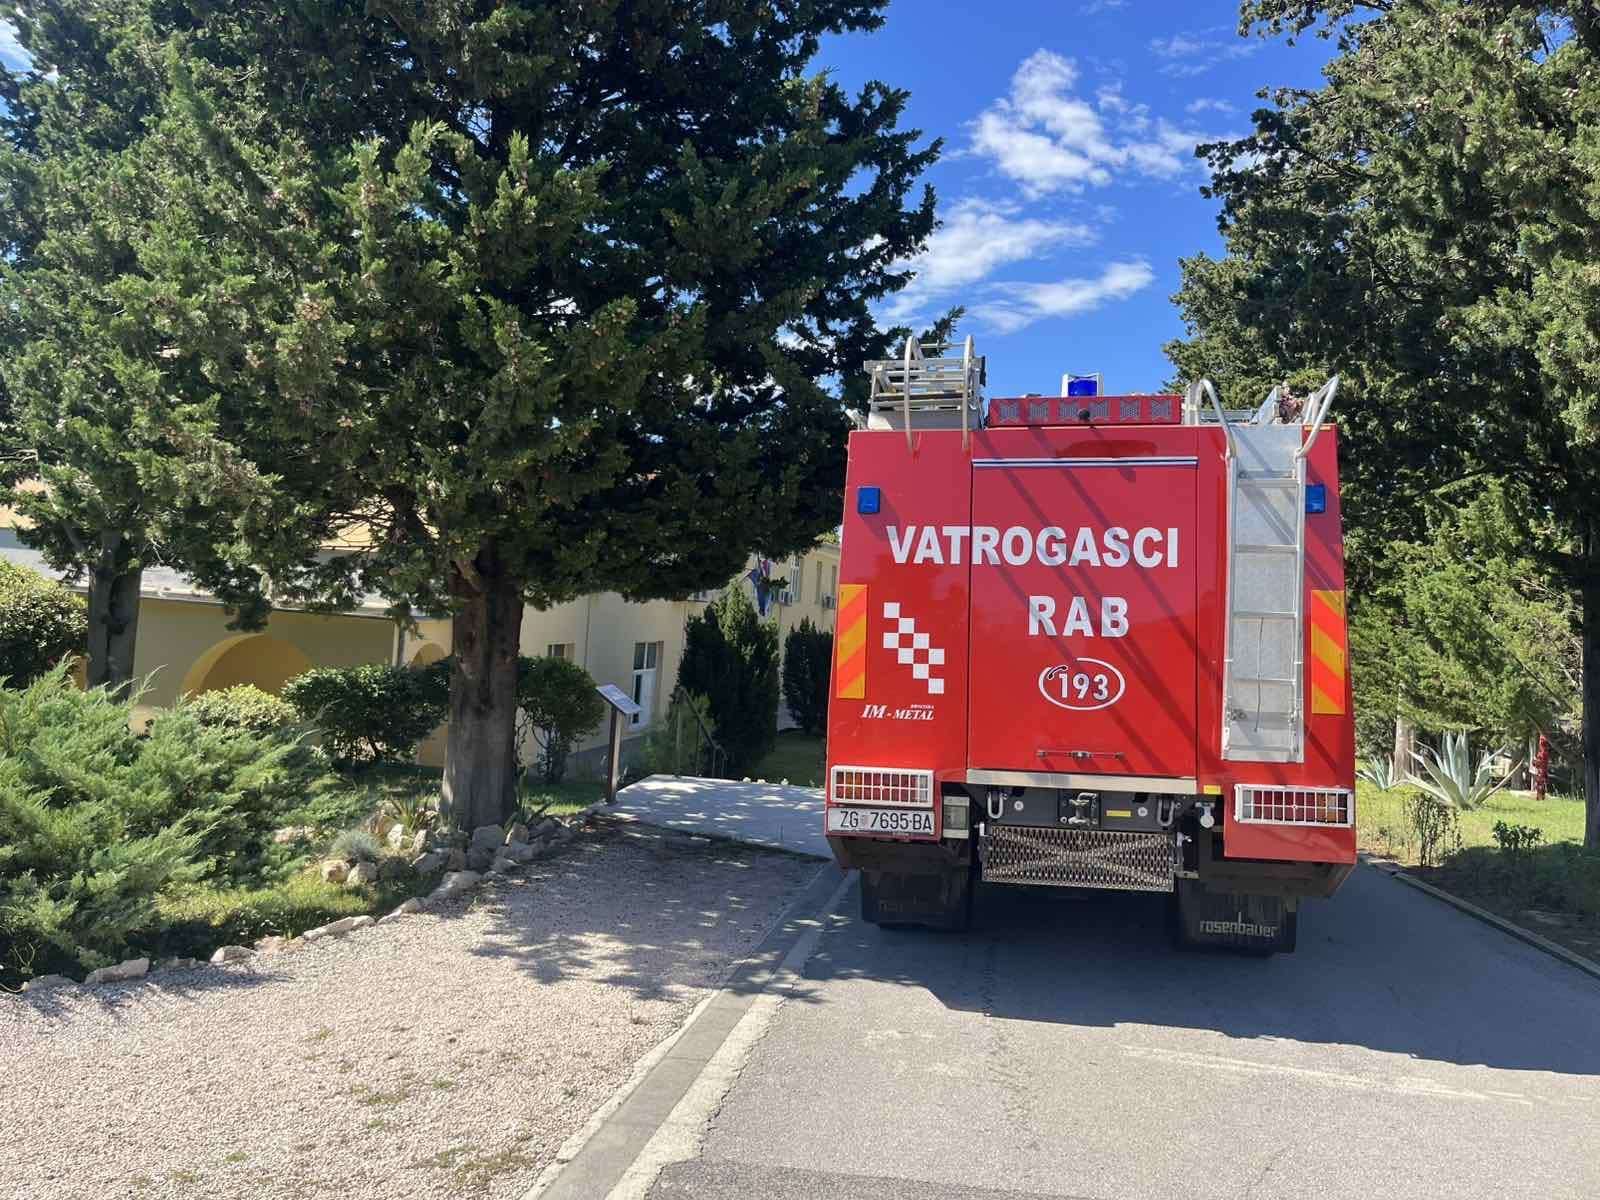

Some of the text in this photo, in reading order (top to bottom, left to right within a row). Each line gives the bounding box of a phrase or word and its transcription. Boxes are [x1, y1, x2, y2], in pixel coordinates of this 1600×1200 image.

[886, 525, 1178, 568] VATROGASCI
[1028, 595, 1129, 638] RAB
[1058, 672, 1108, 700] 193
[840, 811, 859, 828] ZG
[1200, 911, 1279, 937] rosenbauer
